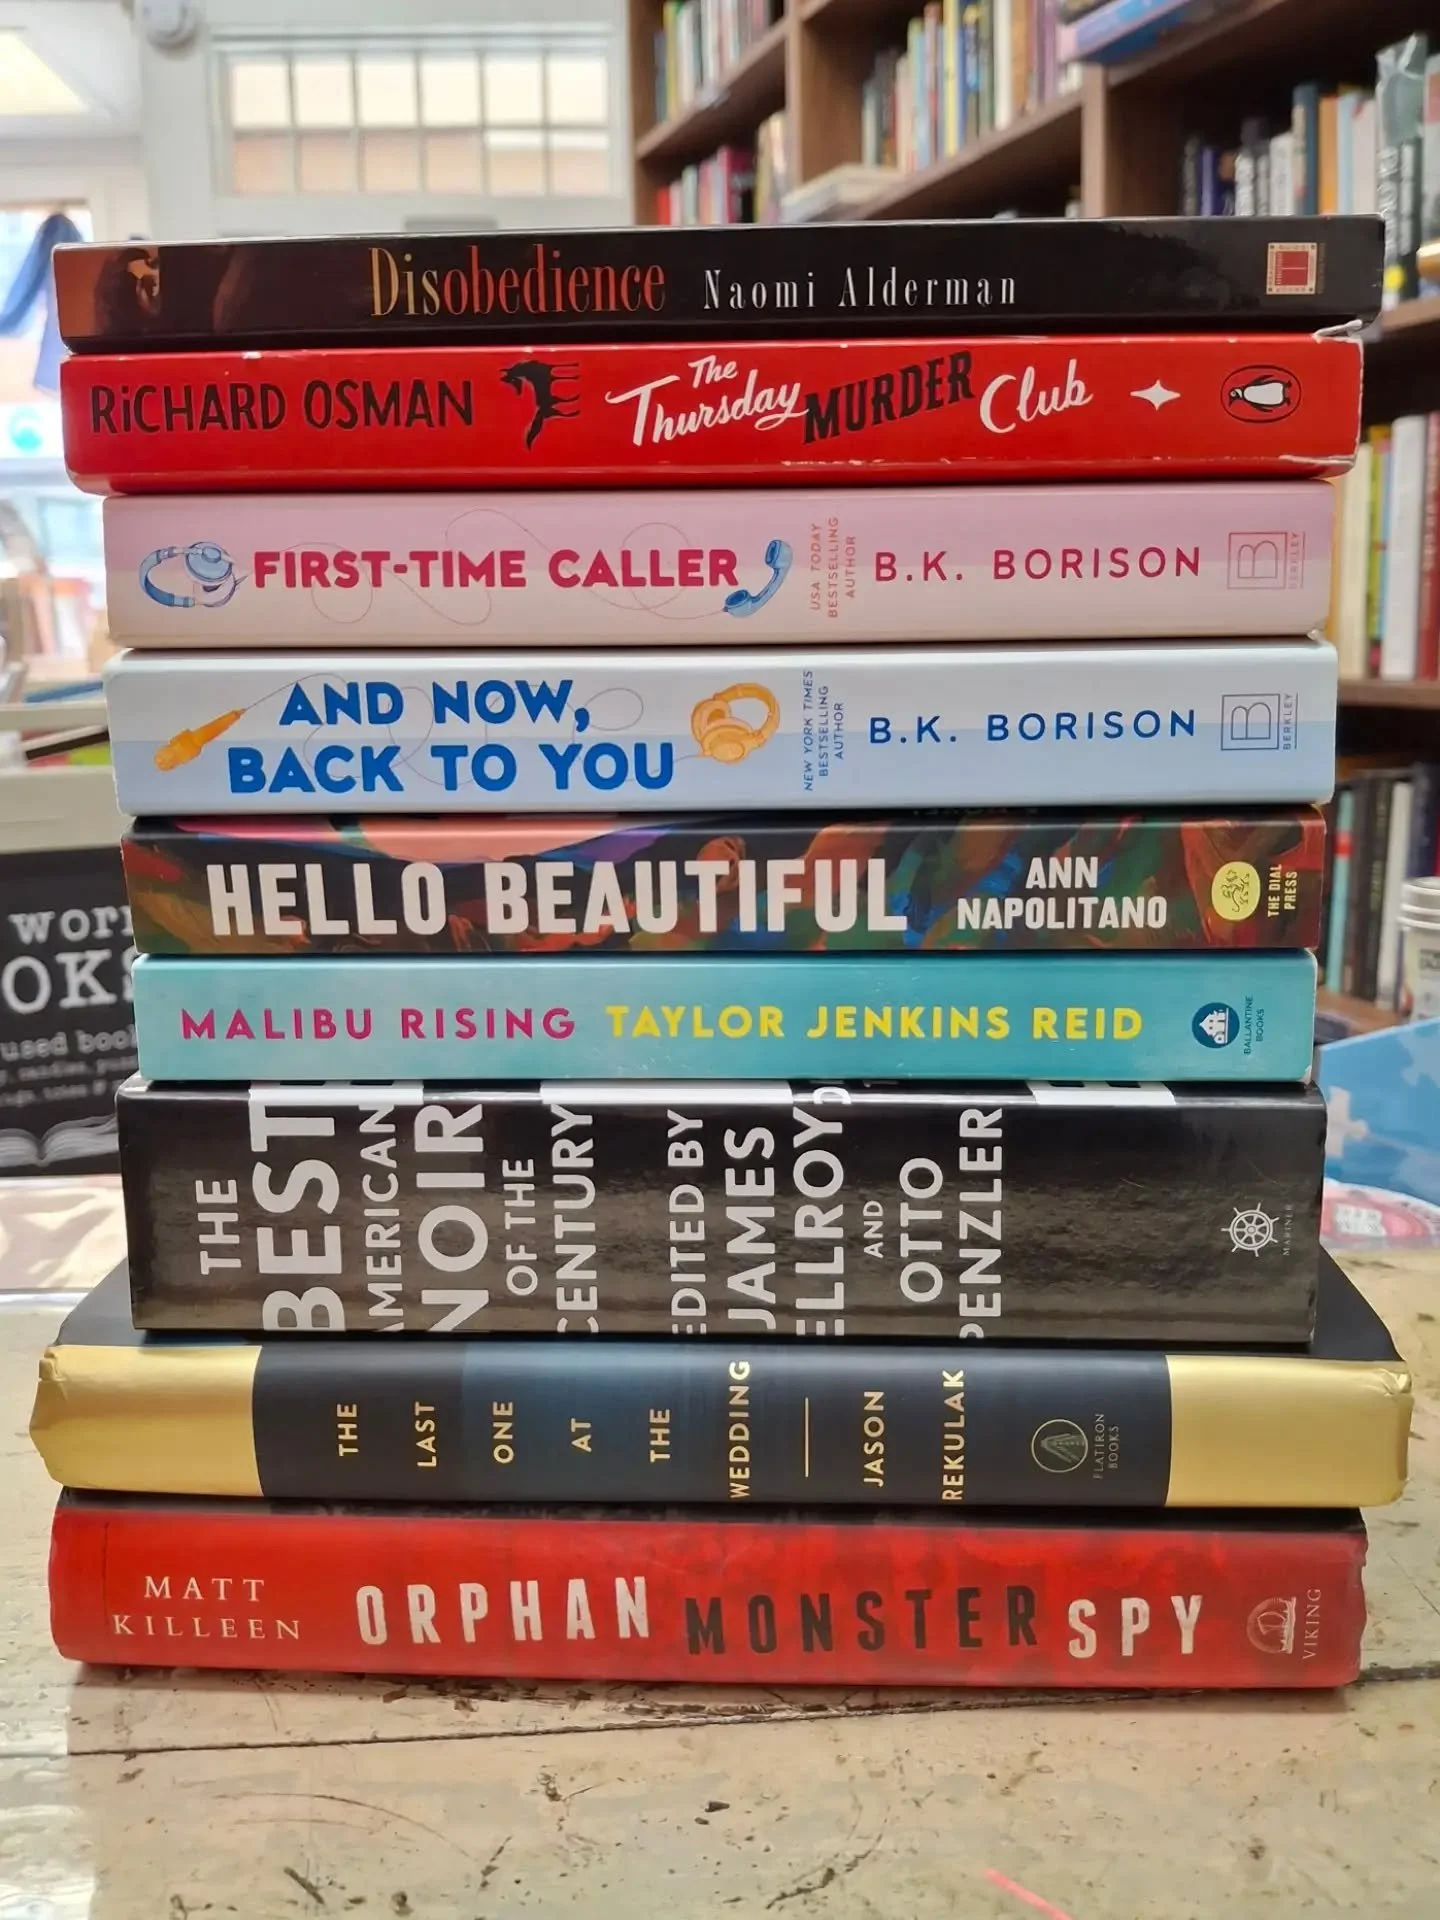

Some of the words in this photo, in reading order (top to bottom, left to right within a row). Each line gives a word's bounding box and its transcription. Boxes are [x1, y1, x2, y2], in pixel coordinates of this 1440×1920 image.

[369, 245, 665, 317] Disobedience
[704, 269, 816, 310] Naomi
[839, 267, 1016, 307] Alderman
[689, 356, 737, 383] The
[304, 380, 473, 429] OSMAN
[605, 369, 808, 447] Thursday
[803, 350, 975, 444] MURDER
[980, 359, 1092, 433] Club
[254, 550, 527, 588] FIRST-TIME
[548, 549, 738, 588] CALLER
[811, 523, 822, 572] TODAY
[828, 517, 838, 618] BESTSELLING
[845, 536, 856, 598] AUTHOR
[875, 551, 962, 581] B.K.
[993, 546, 1200, 580] BORISON
[810, 582, 820, 611] USA
[280, 681, 405, 726] AND
[433, 679, 589, 732] NOW,
[803, 670, 813, 710] TIMES
[803, 719, 813, 759] YORK
[819, 685, 828, 776] BESTSELLING
[834, 703, 844, 760] AUTHOR
[869, 715, 956, 745] B.K.
[987, 710, 1196, 742] BORISON
[1283, 694, 1293, 750] BERKLEY
[228, 746, 403, 793] BACK
[432, 744, 516, 791] TO
[538, 742, 673, 790] YOU
[803, 761, 813, 791] NEW
[206, 862, 444, 936] HELLO
[485, 860, 907, 934] BEAUTIFUL
[1026, 857, 1099, 888] ANN
[1269, 864, 1282, 890] DIAL
[1284, 871, 1297, 909] PRESS
[958, 896, 1167, 930] NAPOLITANO
[1268, 894, 1280, 917] THE
[181, 1008, 372, 1039] MALIBU
[400, 1007, 575, 1039] RISING
[606, 1005, 784, 1038] TAYLOR
[806, 1007, 1010, 1040] JENKINS
[1033, 1007, 1142, 1040] REID
[1244, 996, 1253, 1055] BALLANTINE
[1256, 1008, 1264, 1042] BOOKS
[667, 1109, 704, 1168] BY
[249, 1098, 346, 1331] BEST
[359, 1104, 404, 1332] MERICAN
[414, 1103, 490, 1331] NOIR
[502, 1159, 536, 1229] THE
[196, 1179, 242, 1275] THE
[723, 1126, 776, 1330] JAMES
[863, 1200, 883, 1259] AND
[900, 1157, 943, 1302] OTTO
[506, 1245, 538, 1296] OF
[337, 1402, 359, 1458] THE
[414, 1401, 436, 1468] LAST
[493, 1400, 515, 1464] ONE
[571, 1418, 592, 1453] AT
[649, 1407, 671, 1464] THE
[729, 1360, 751, 1499] WEDDING
[863, 1391, 884, 1488] JASON
[942, 1369, 965, 1501] REKULAK
[1093, 1413, 1105, 1479] FLATIRON
[1108, 1425, 1119, 1469] BOOKS
[144, 1575, 266, 1600] MATT
[112, 1613, 301, 1641] KILLEEN
[356, 1576, 650, 1646] ORPHAN
[686, 1583, 1037, 1657] MONSTER
[1067, 1594, 1203, 1659] SPY
[1302, 1589, 1321, 1659] VIKING
